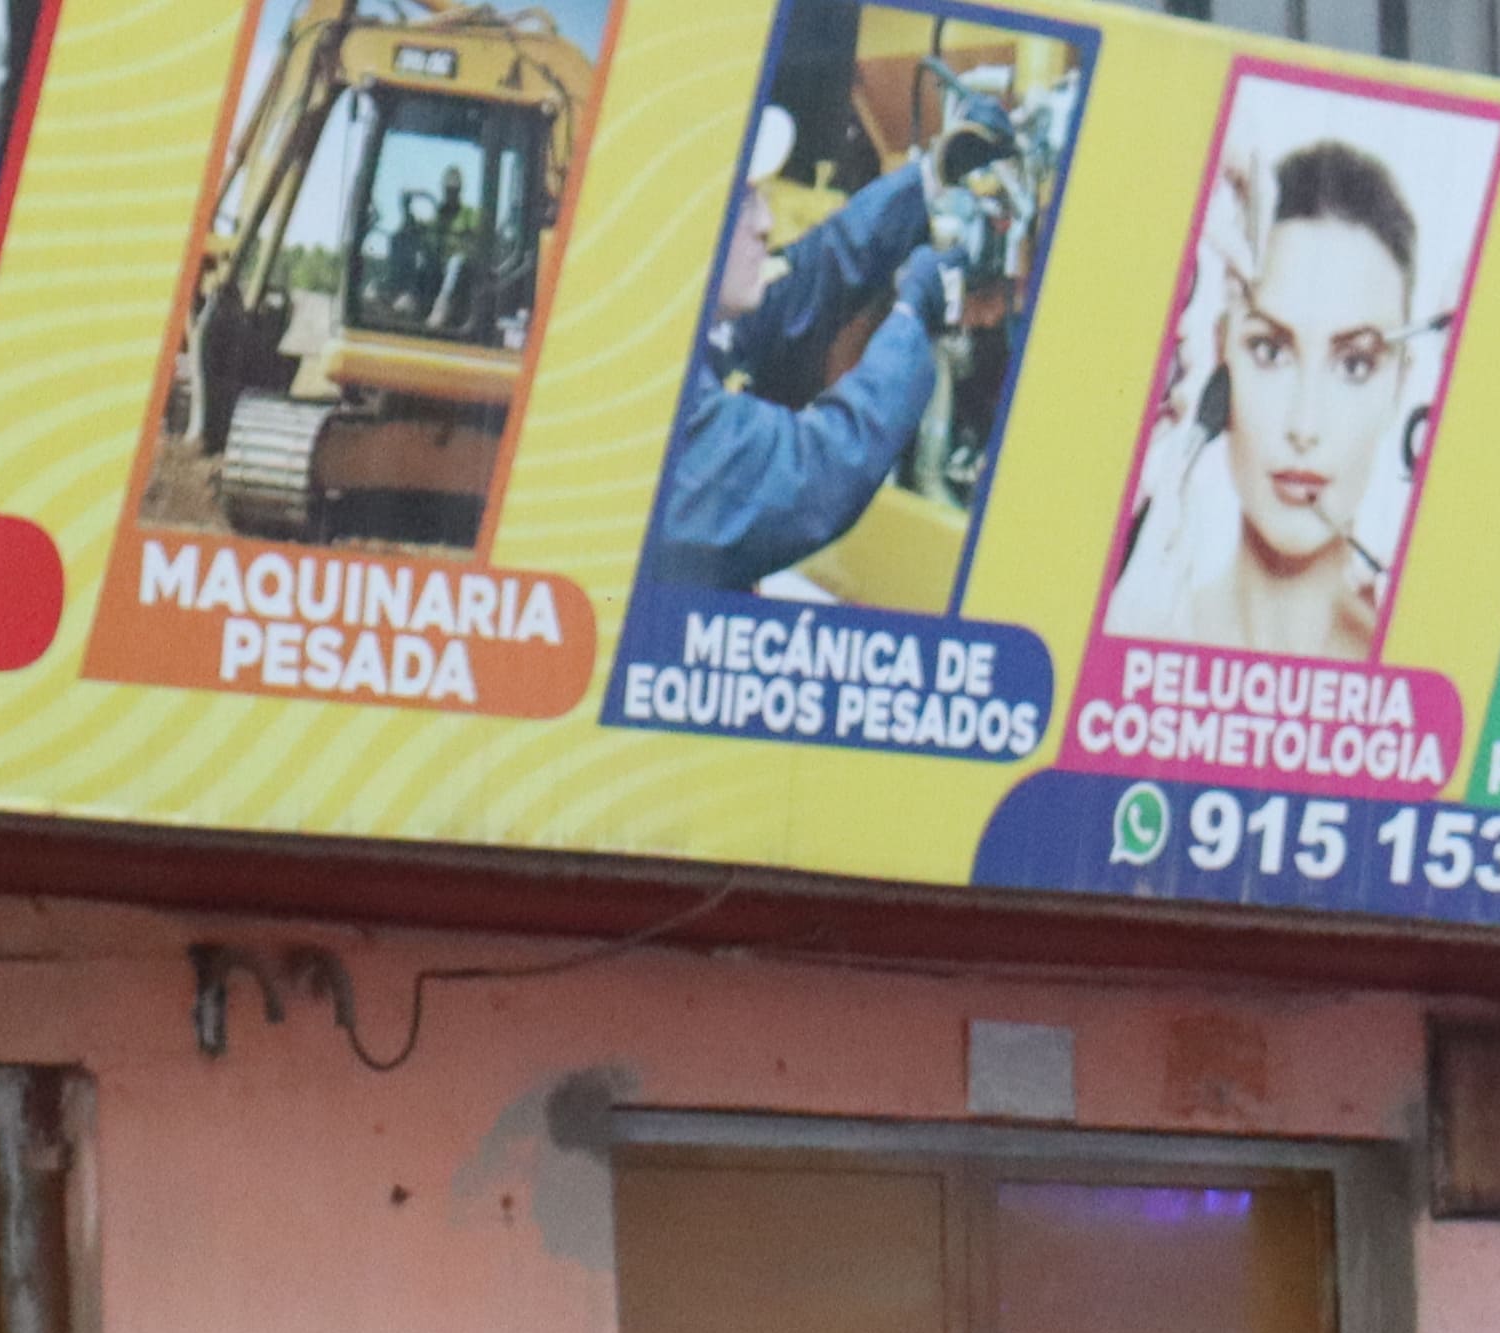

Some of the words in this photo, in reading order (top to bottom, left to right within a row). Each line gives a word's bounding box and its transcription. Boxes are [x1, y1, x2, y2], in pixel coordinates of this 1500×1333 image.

[138, 541, 562, 645] MAQUINARIA
[219, 620, 478, 704] PESADA
[684, 609, 924, 687] MECÁNICA
[935, 640, 994, 695] DE
[1122, 650, 1414, 728] PELUQUERIA
[624, 663, 824, 735] EQUIPOS
[836, 687, 1038, 754] PESADOS
[1188, 792, 1348, 880] 915
